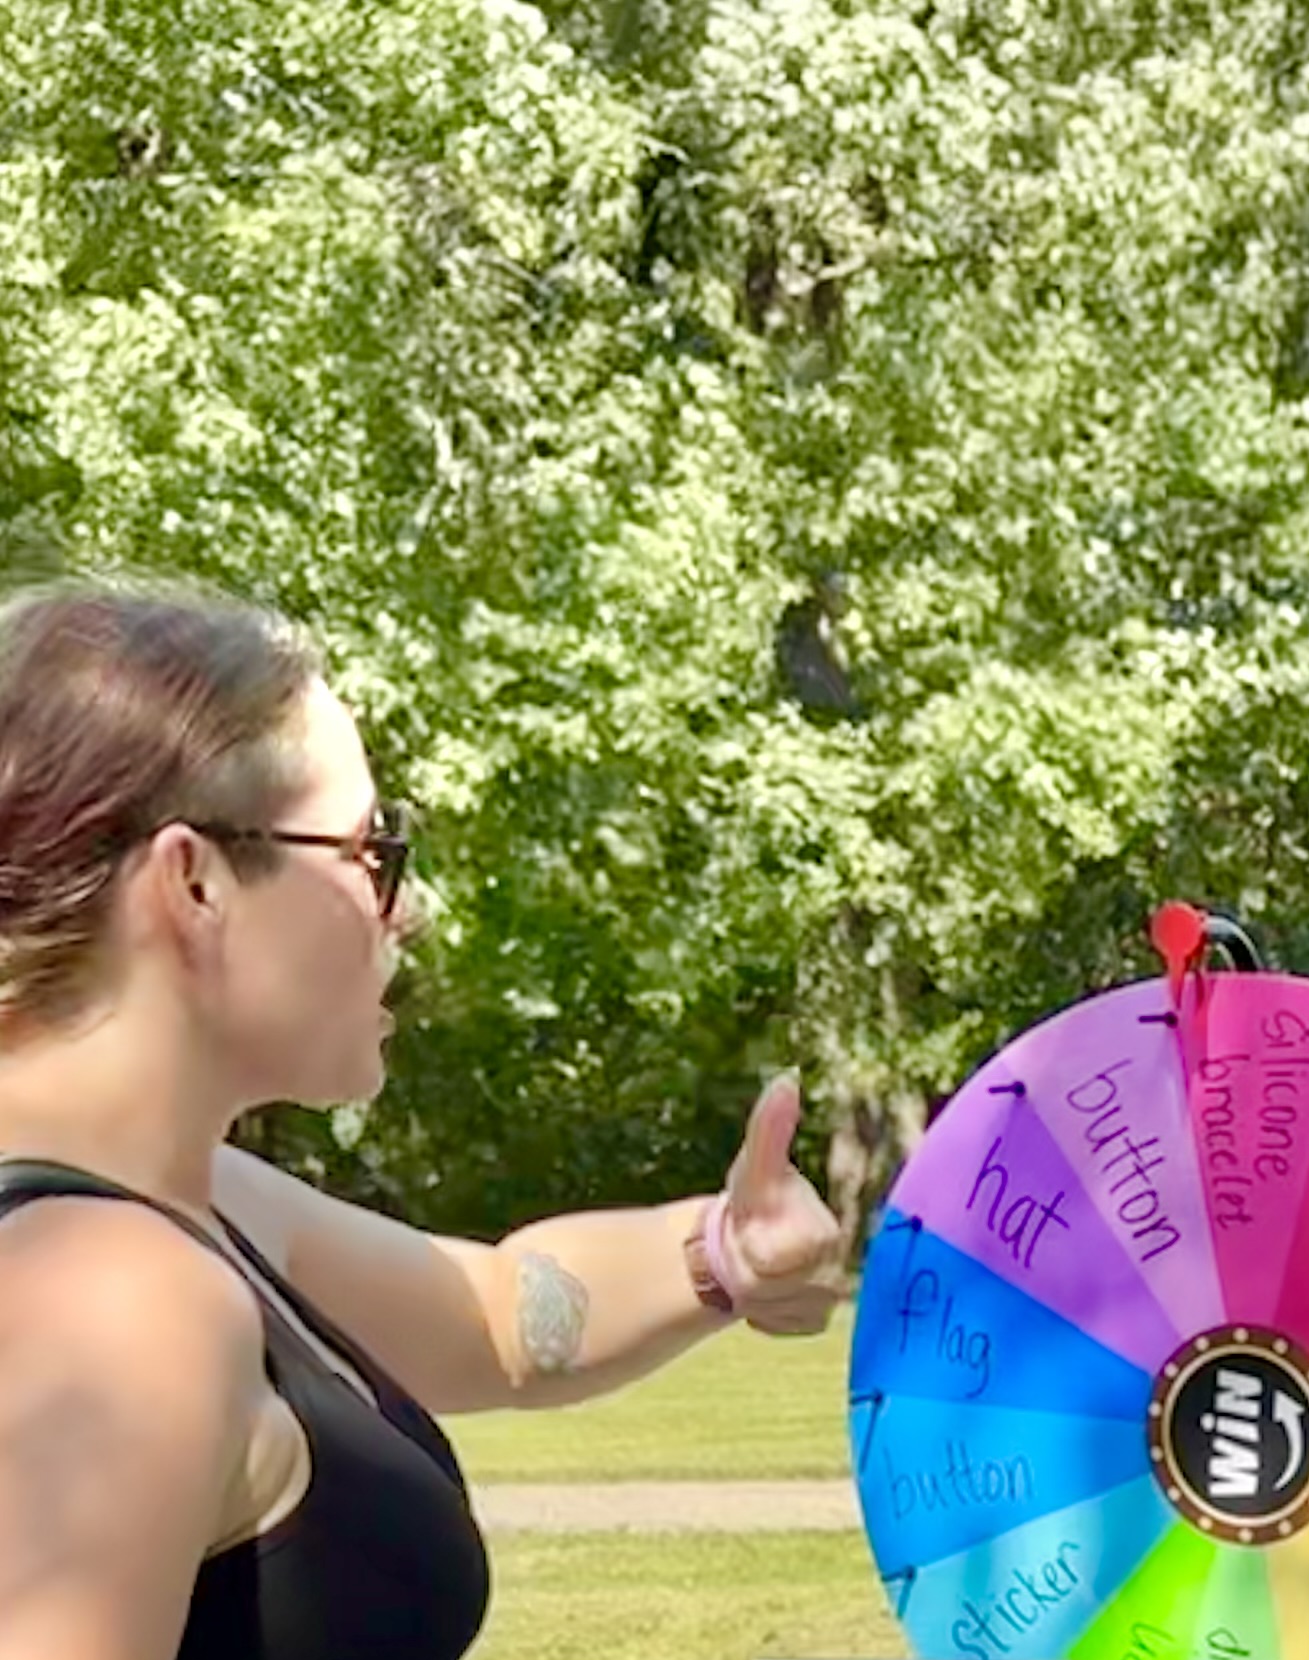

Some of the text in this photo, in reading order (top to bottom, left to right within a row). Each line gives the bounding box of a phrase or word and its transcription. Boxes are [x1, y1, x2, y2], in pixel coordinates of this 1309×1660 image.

[966, 1137, 1070, 1268] hat
[1067, 1059, 1181, 1262] button
[1199, 1054, 1253, 1230] bracelet
[898, 1268, 990, 1399] flag
[883, 1437, 1034, 1519] button
